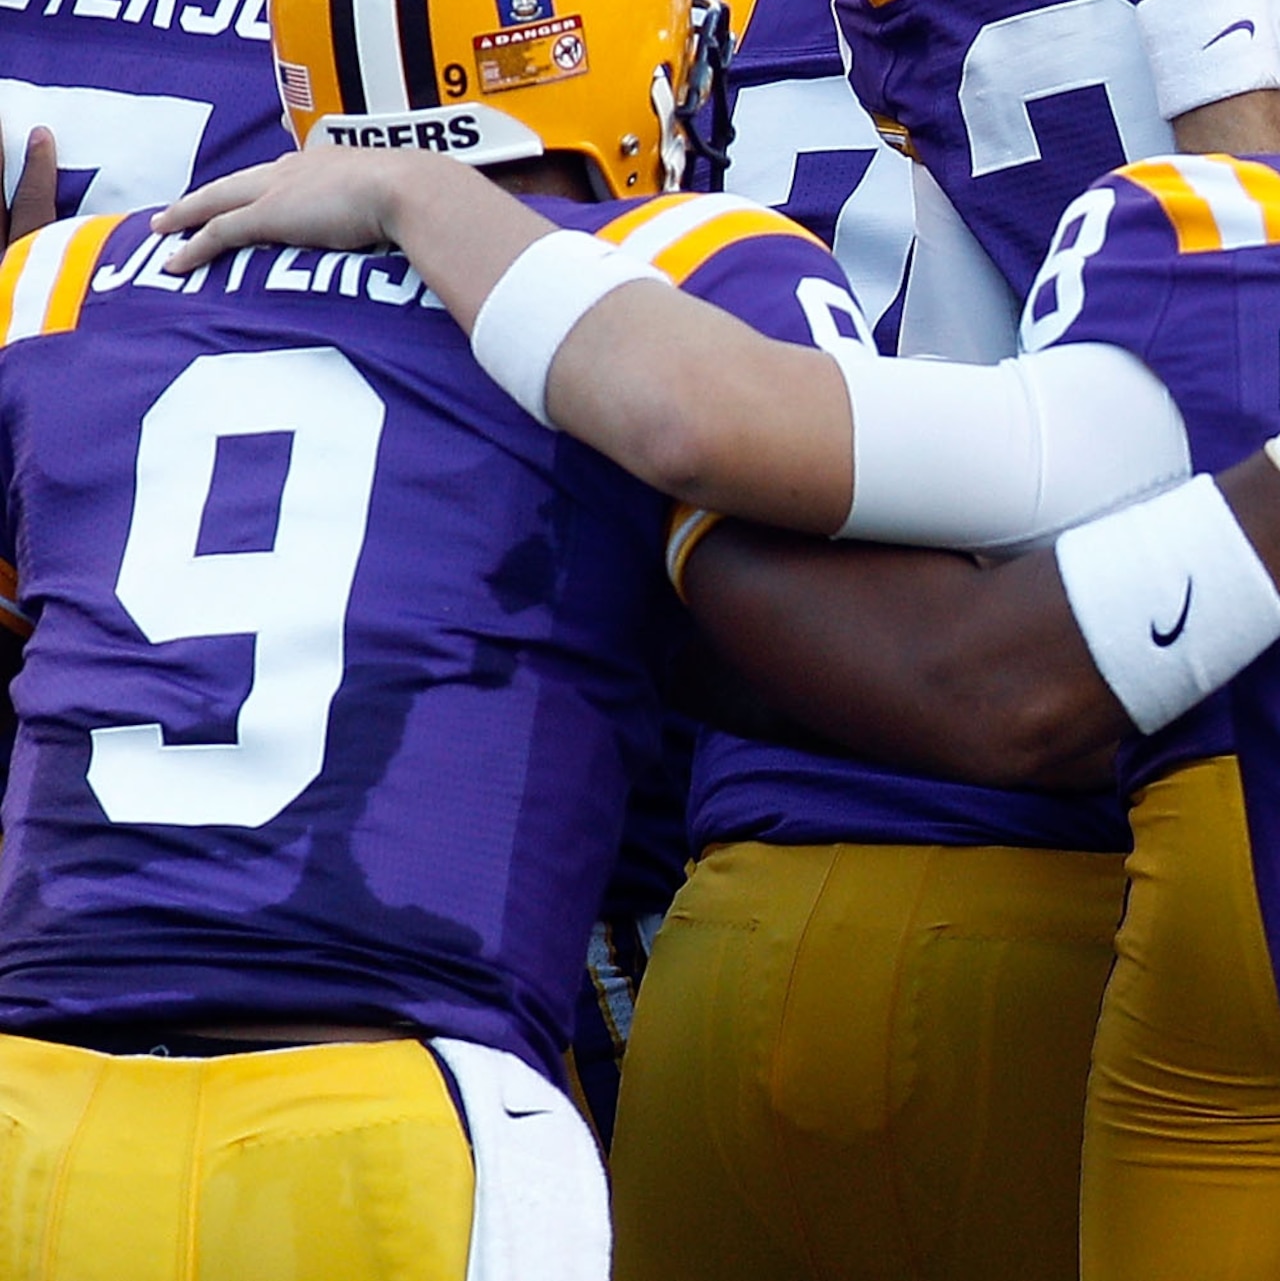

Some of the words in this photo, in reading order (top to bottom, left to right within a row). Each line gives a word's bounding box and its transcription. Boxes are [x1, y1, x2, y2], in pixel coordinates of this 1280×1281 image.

[494, 19, 577, 46] DANGER
[443, 63, 468, 98] 9
[86, 347, 386, 829] 9
